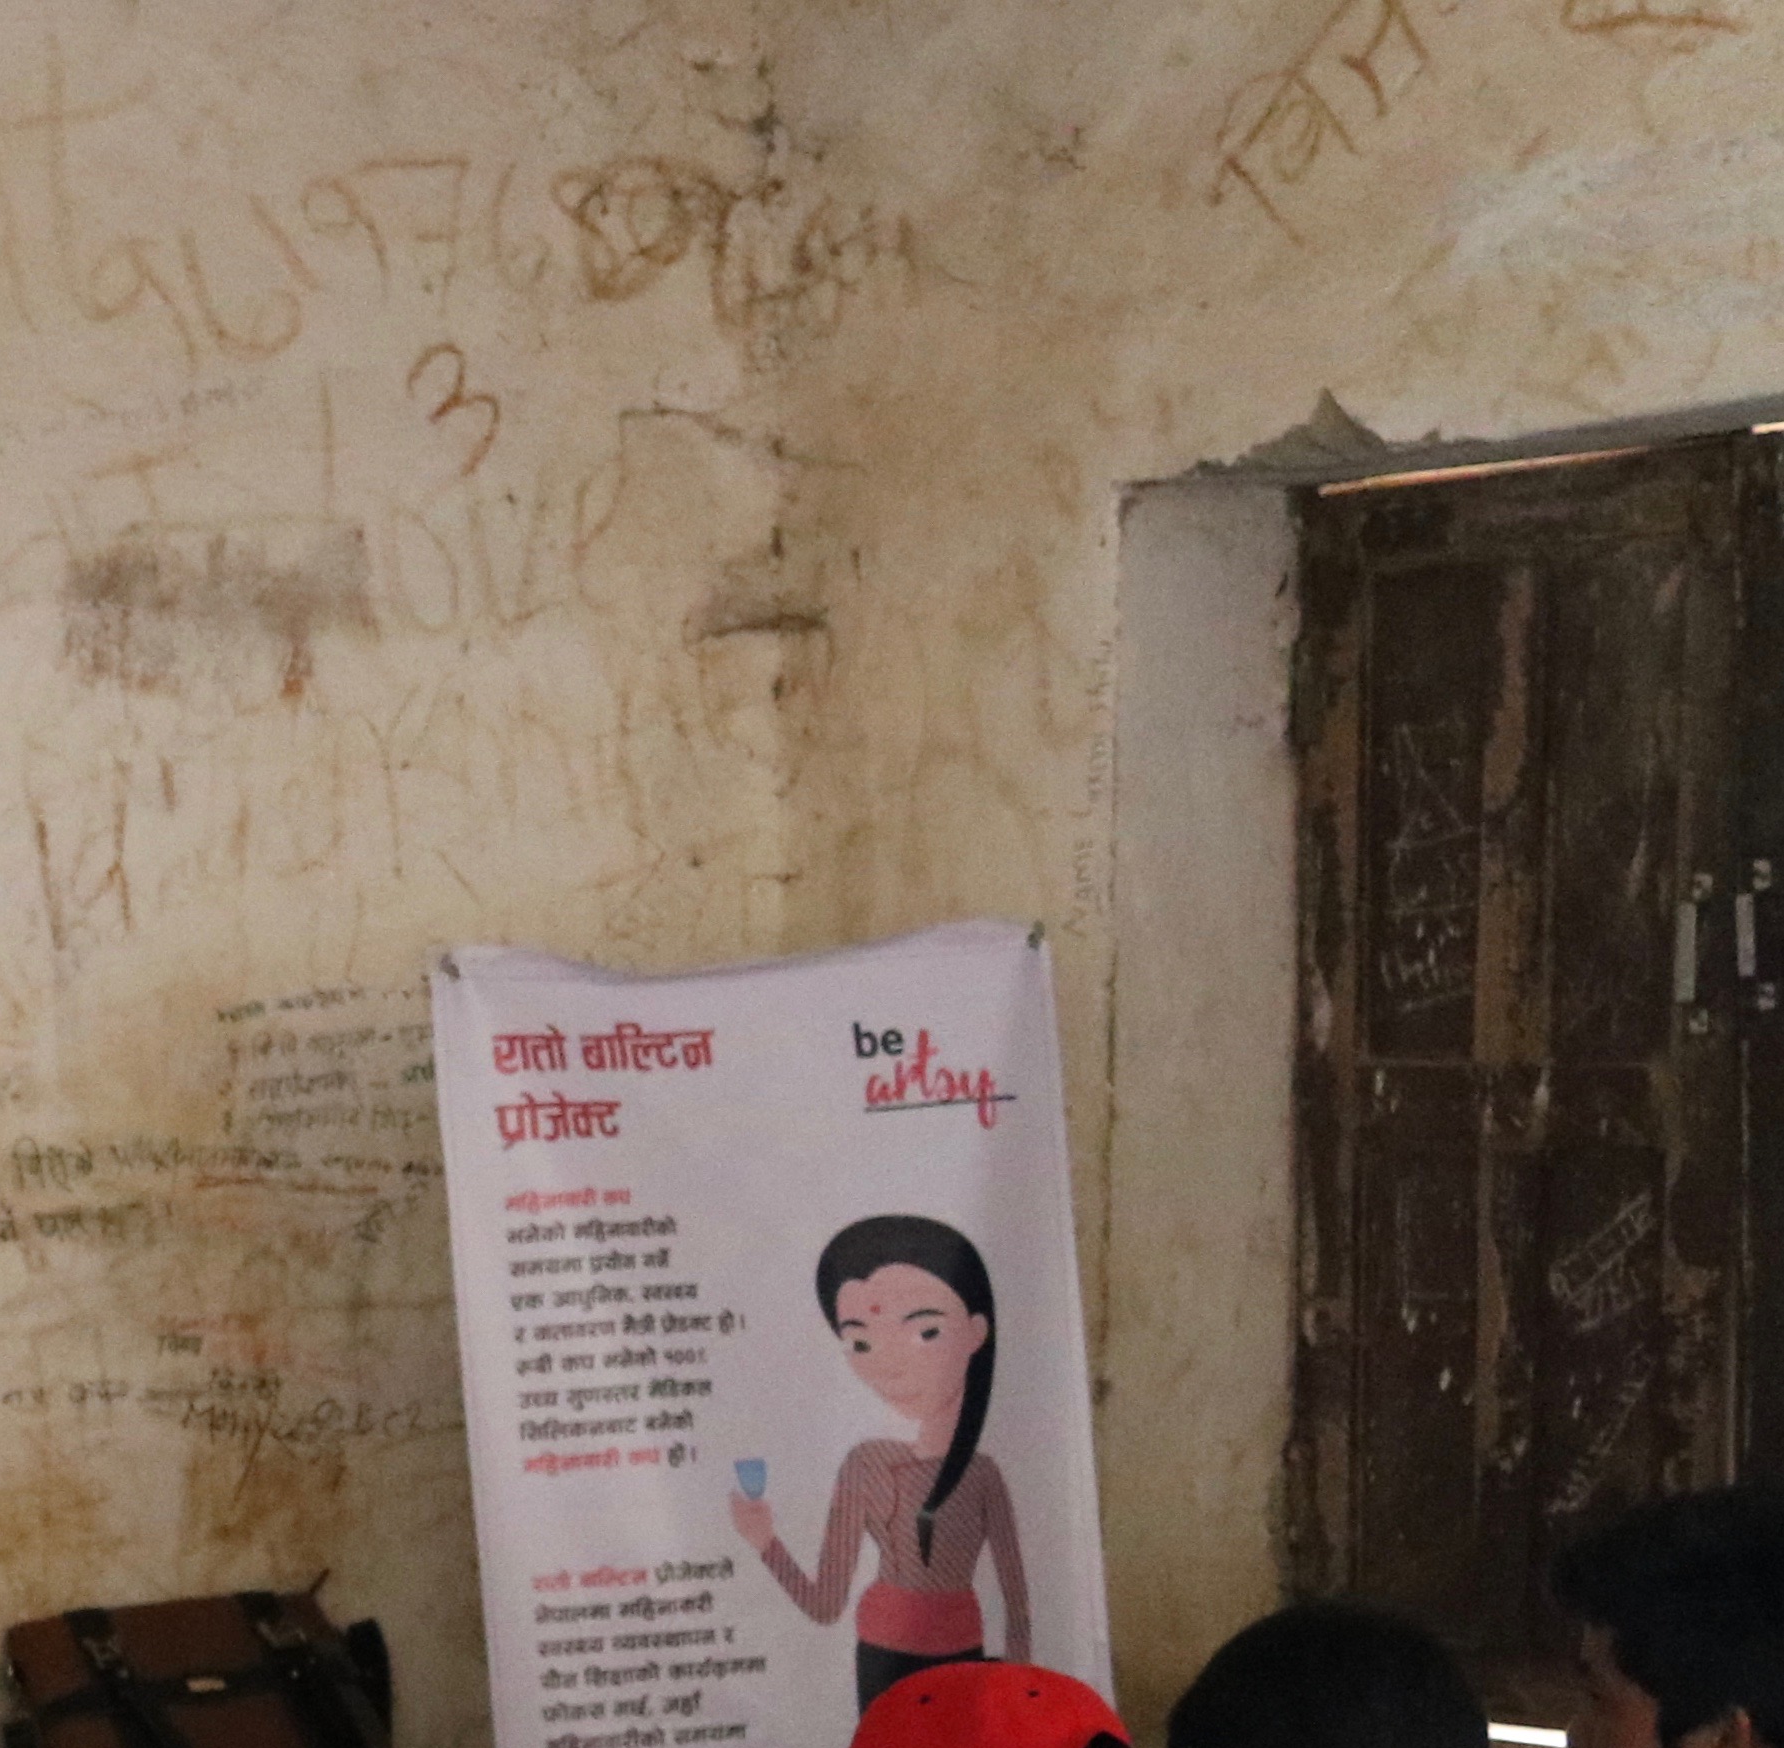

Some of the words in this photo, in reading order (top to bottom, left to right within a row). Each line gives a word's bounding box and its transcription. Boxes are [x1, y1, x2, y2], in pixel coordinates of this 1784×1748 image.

[492, 1024, 567, 1075] रातो
[580, 1022, 715, 1073] बाल्टिन
[853, 1021, 904, 1059] be
[494, 1091, 621, 1152] प्रोजेक्ट
